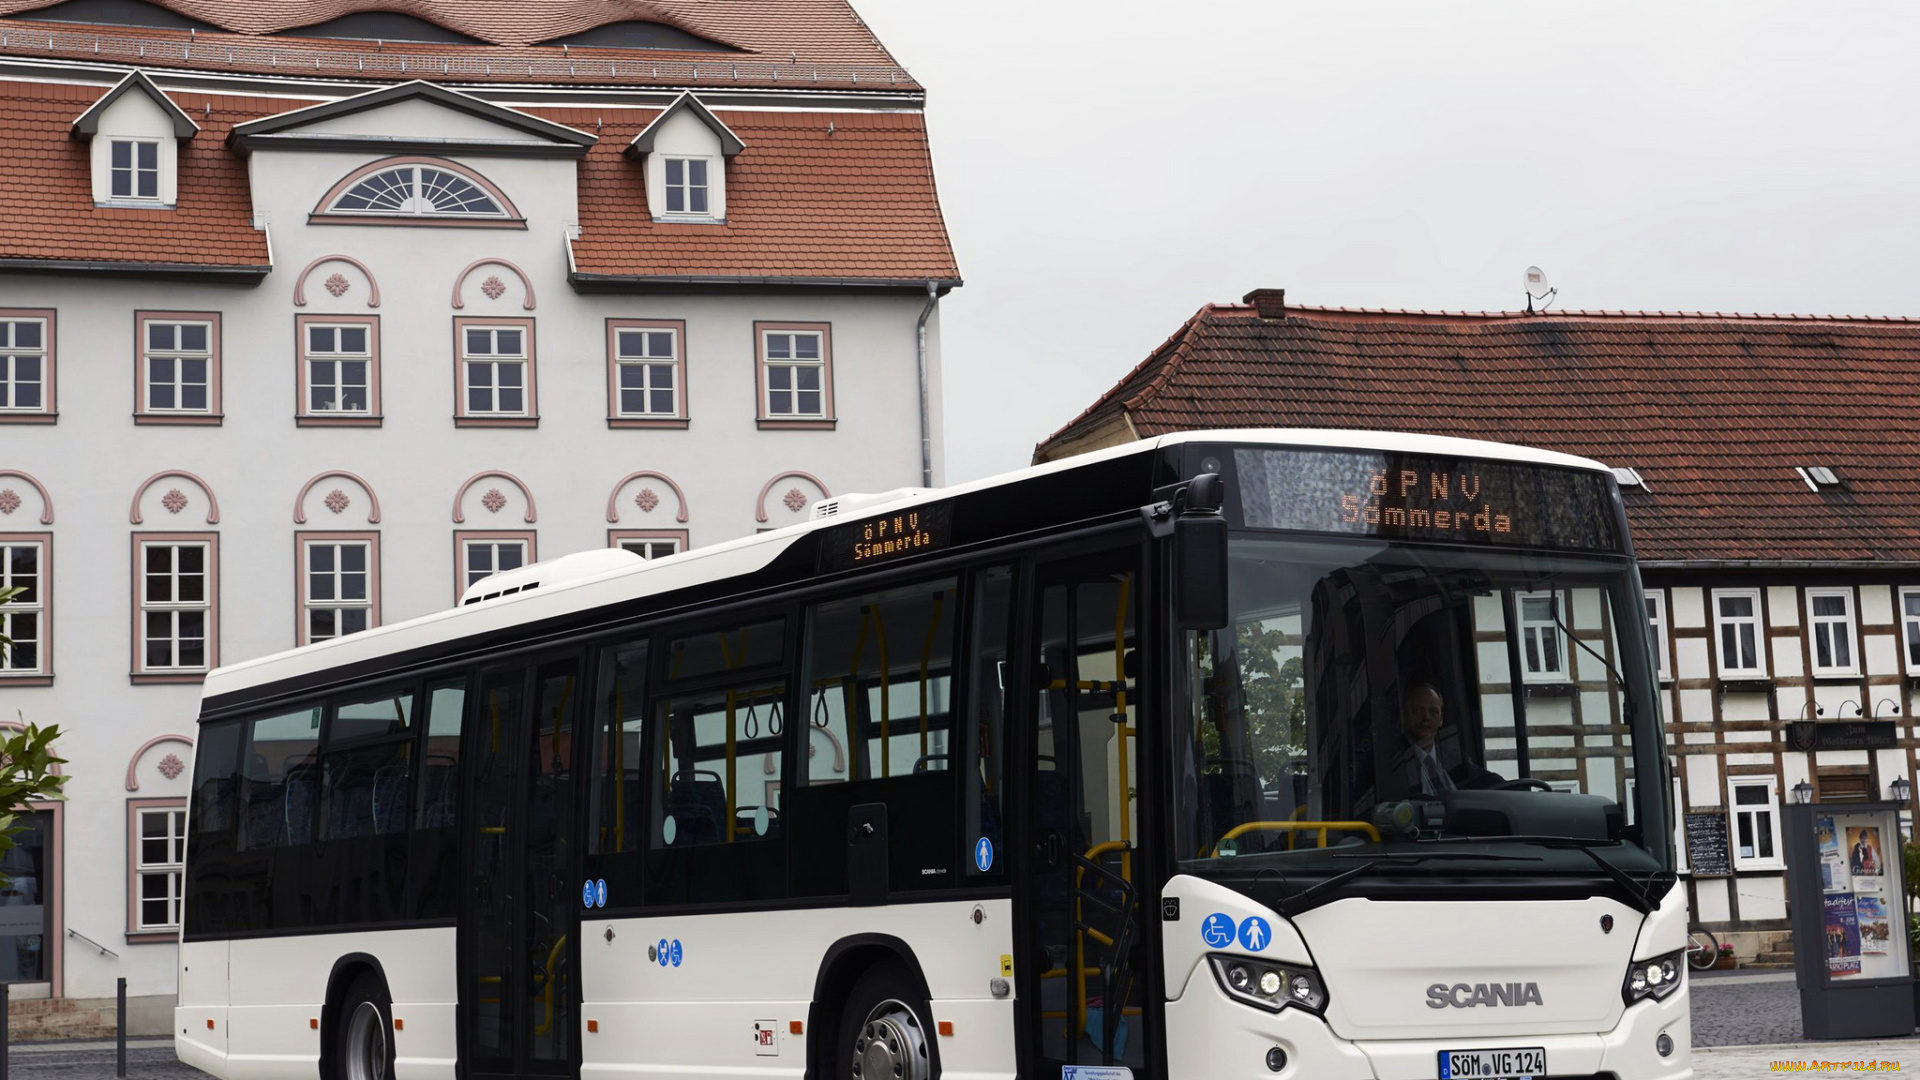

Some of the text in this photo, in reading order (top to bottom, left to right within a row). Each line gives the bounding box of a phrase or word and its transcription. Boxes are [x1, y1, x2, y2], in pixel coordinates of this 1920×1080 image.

[1342, 495, 1511, 533] Sömmerda
[854, 530, 930, 560] Sömmerda
[1824, 896, 1855, 908] tadtfest
[1829, 961, 1860, 970] ARKTPLATZ
[1426, 982, 1544, 1009] SCANIA
[1451, 1052, 1543, 1076] SÖM VG 124
